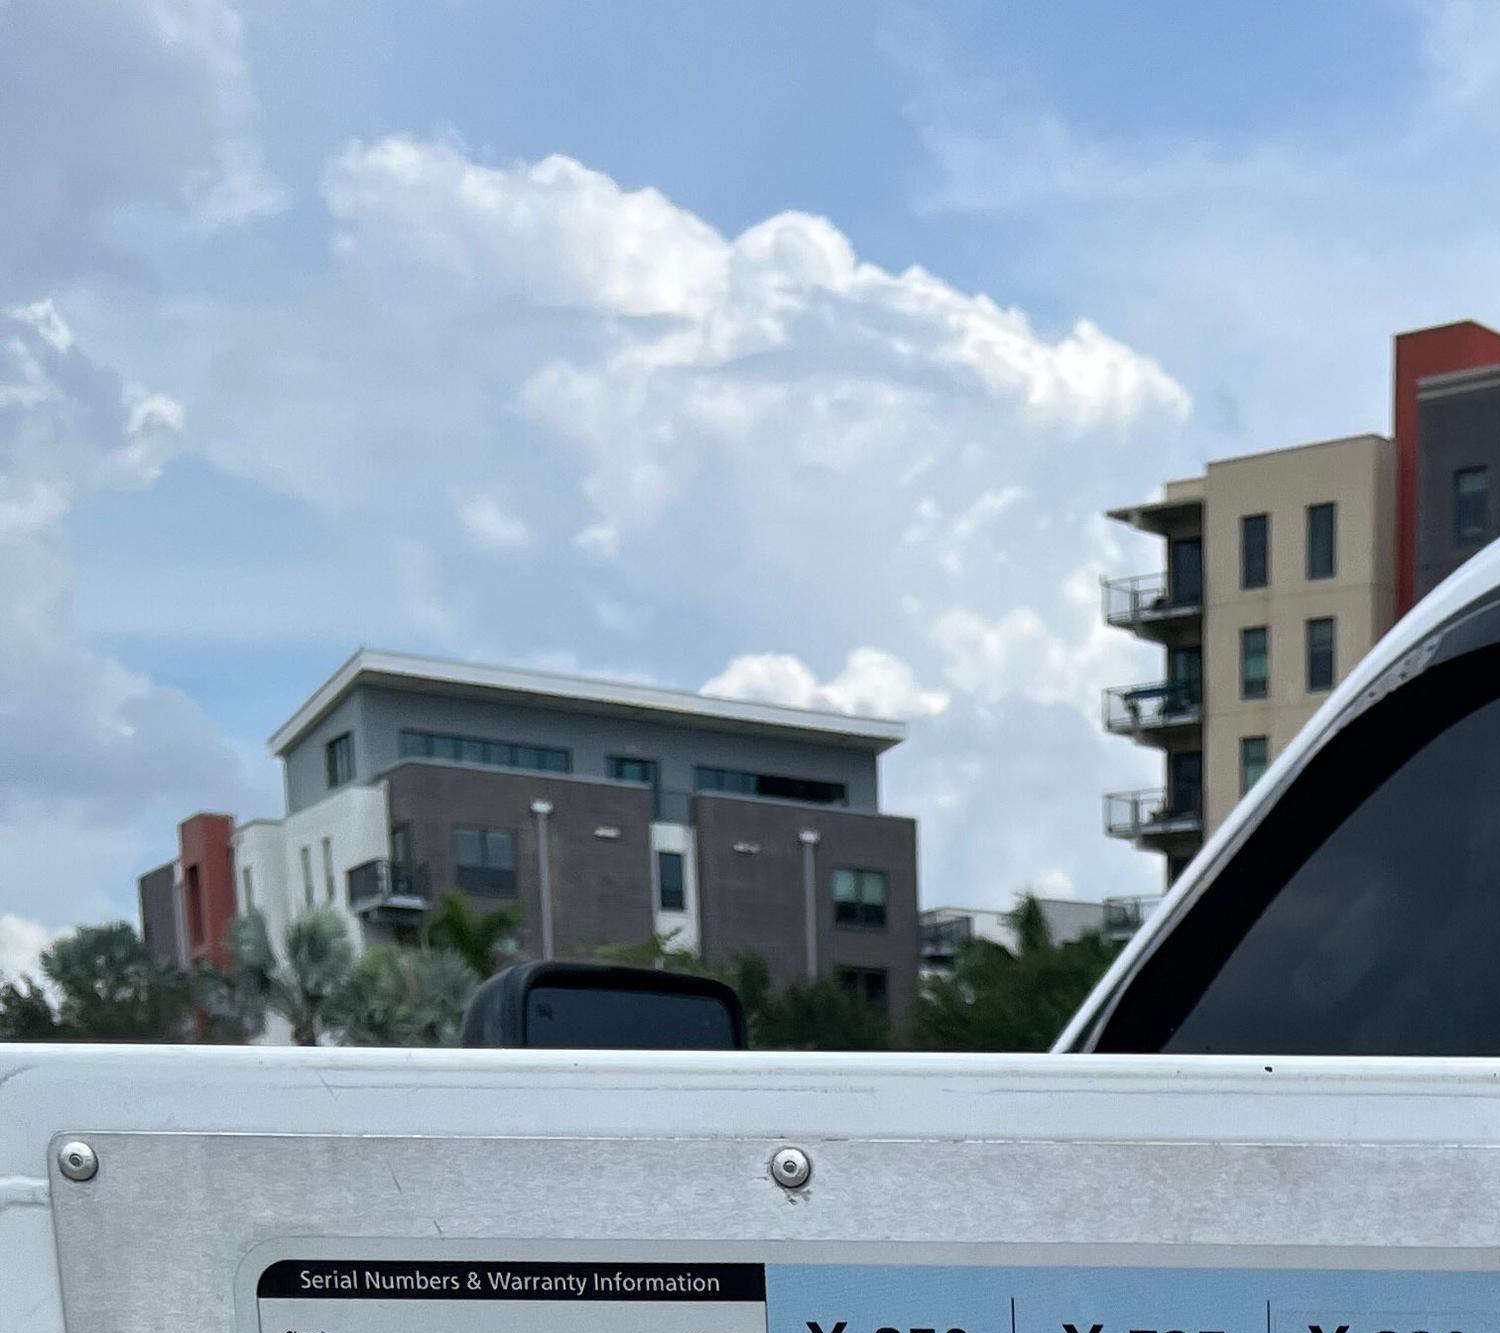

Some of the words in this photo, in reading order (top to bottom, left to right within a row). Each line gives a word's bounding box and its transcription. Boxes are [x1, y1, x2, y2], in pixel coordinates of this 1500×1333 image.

[300, 1269, 358, 1290] Serial
[364, 1270, 460, 1290] Numbers
[467, 1271, 482, 1290] &
[487, 1271, 587, 1296] Warranty
[593, 1271, 720, 1292] Information
